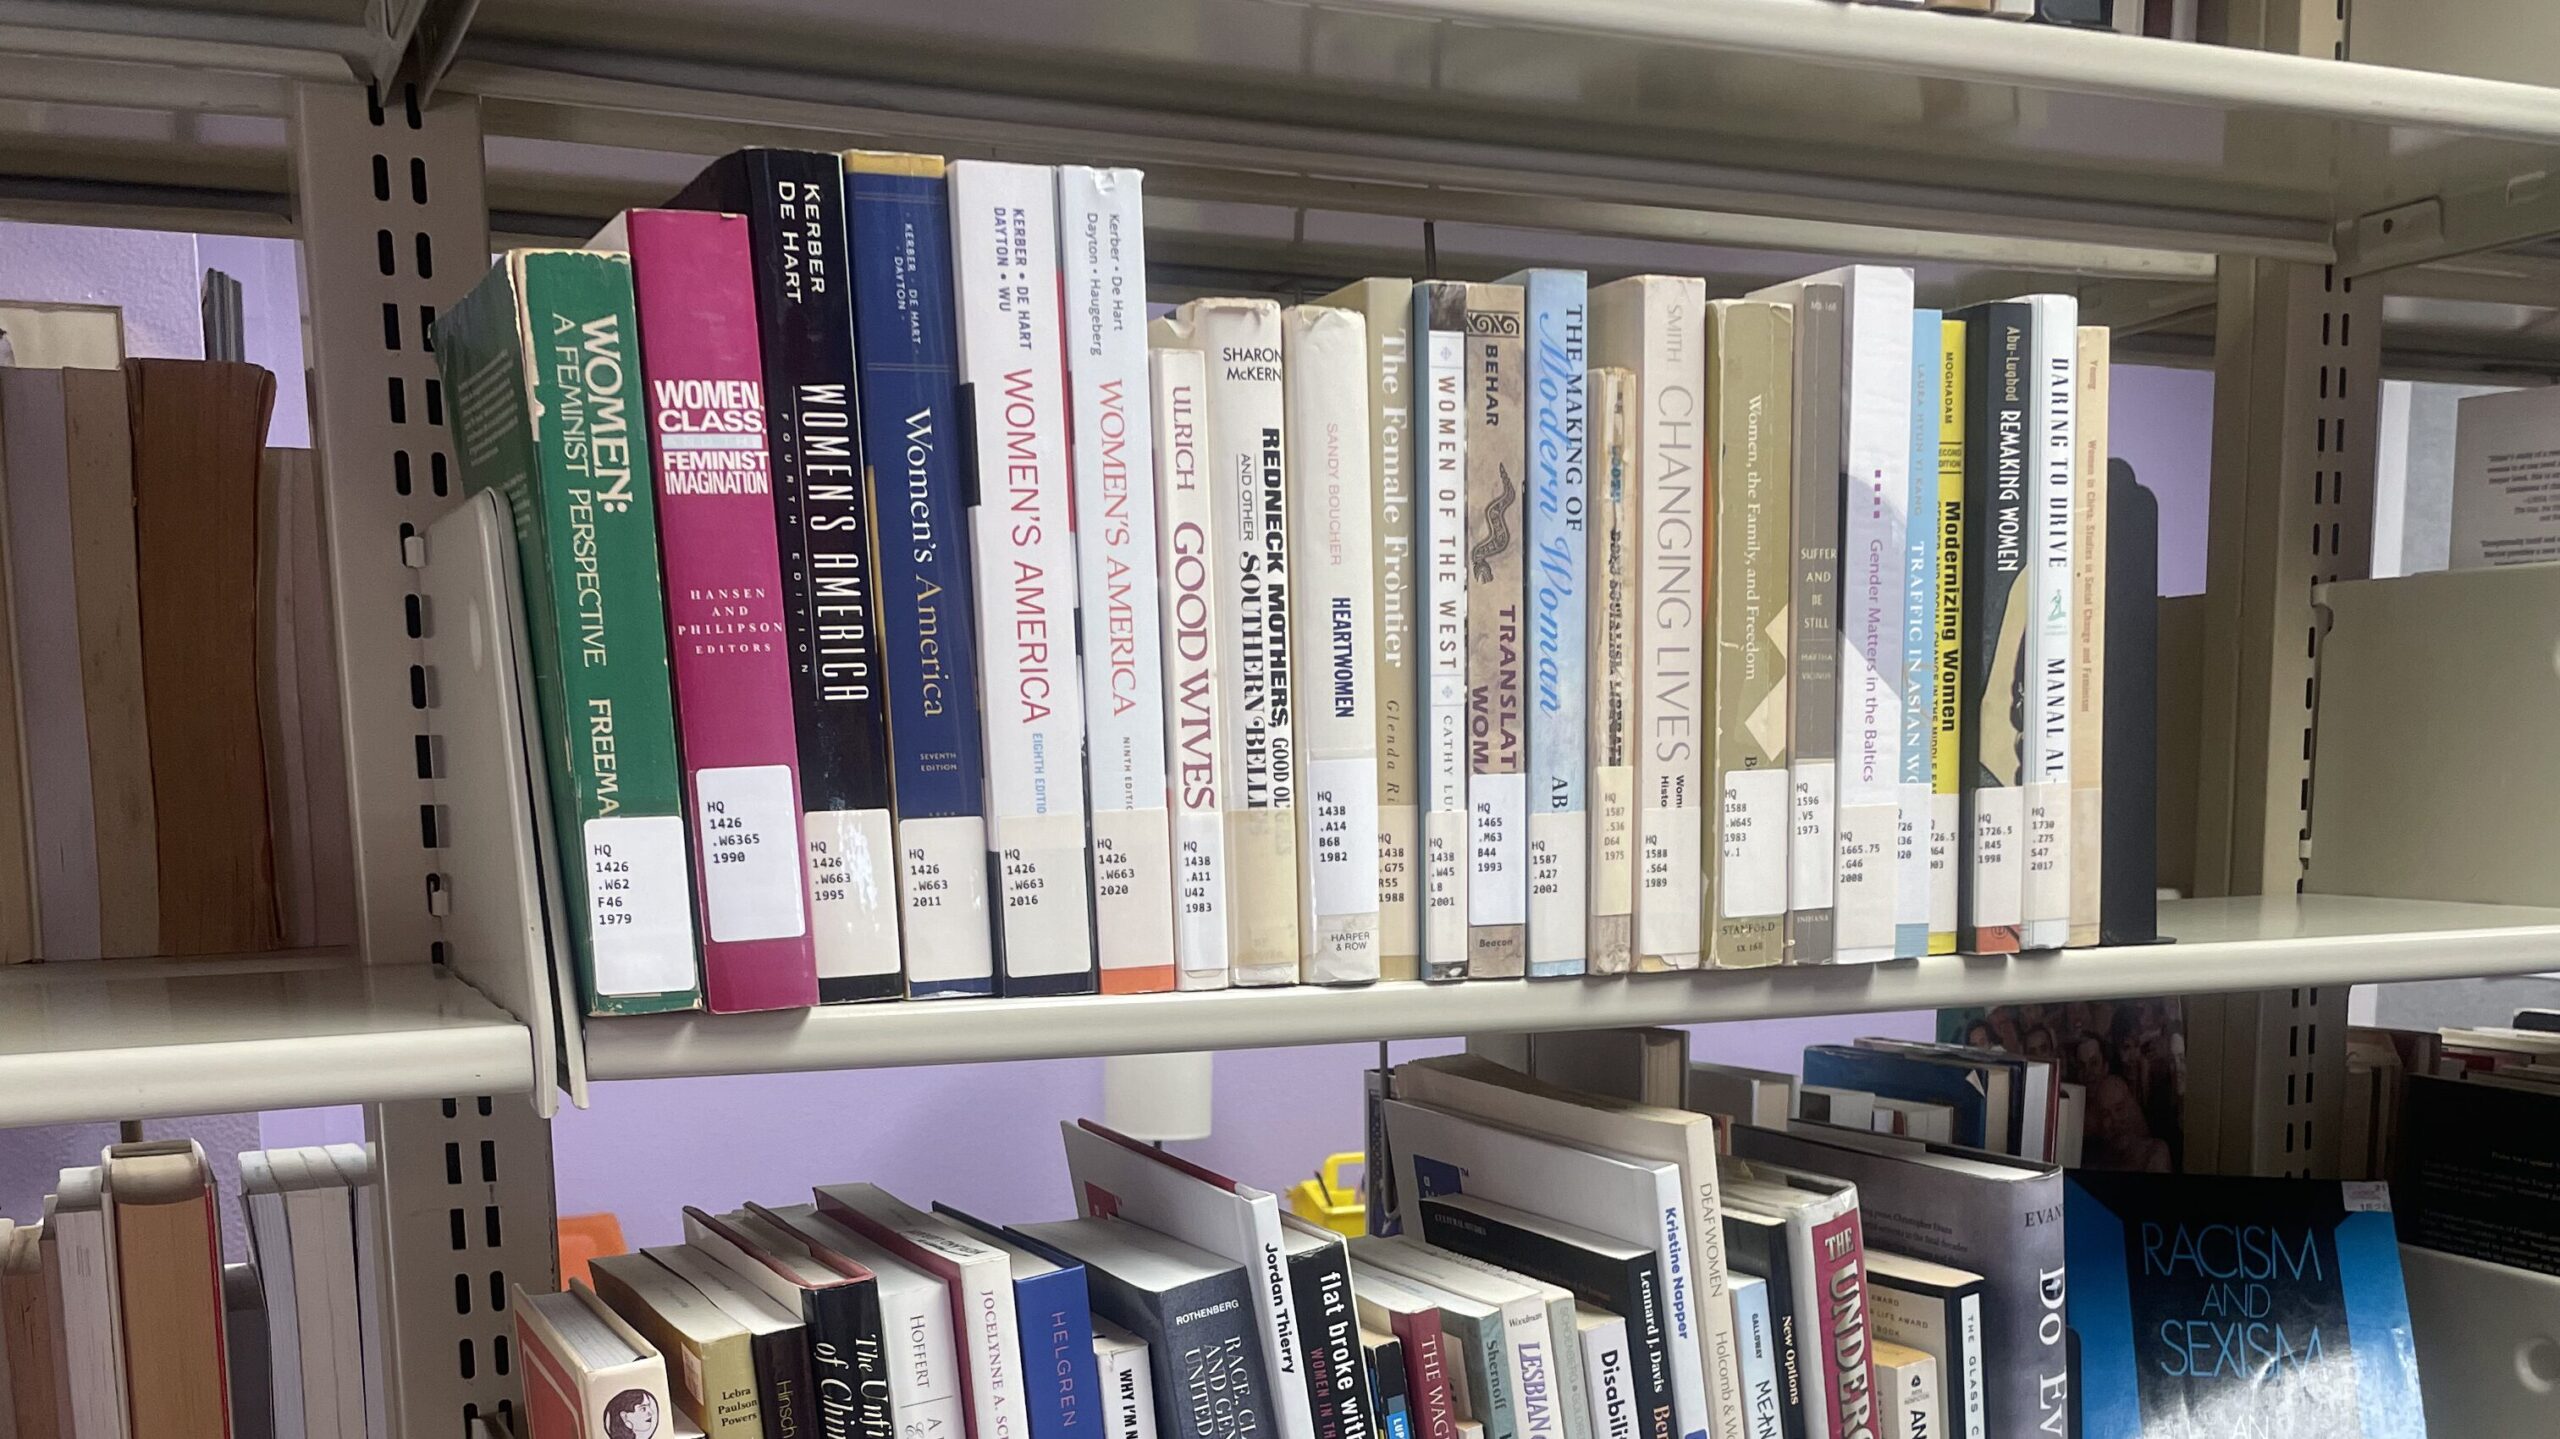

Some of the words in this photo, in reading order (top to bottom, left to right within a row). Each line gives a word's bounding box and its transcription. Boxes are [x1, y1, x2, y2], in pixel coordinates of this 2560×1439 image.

[778, 180, 796, 221] DE
[803, 182, 826, 294] KERBER
[993, 206, 1010, 267] DAYTON
[1012, 208, 1029, 267] KERBER
[1085, 212, 1099, 265] Dayton
[1109, 213, 1124, 263] Kerber
[782, 231, 802, 304] HART
[1018, 307, 1033, 351] HART
[1089, 278, 1103, 357] Haugeberg
[1566, 304, 1583, 363] THE
[1666, 303, 1683, 363] SMITH
[1382, 328, 1407, 395] The
[1485, 343, 1499, 427] BEHAR
[2005, 325, 2021, 403] Abu-Lughod
[555, 345, 590, 479] FEMINIST
[581, 313, 633, 513] WOMEN:
[654, 379, 766, 412] WOMEN,
[658, 409, 768, 435] CLASS,
[1539, 311, 1574, 523] Modern
[2051, 358, 2069, 448] DARING
[1172, 385, 1196, 492] ULRICH
[1438, 375, 1456, 472] WOMEN
[1566, 373, 1583, 486] MAKING
[663, 450, 769, 471] FEMINIST
[801, 384, 858, 532] WOMEN'S
[1003, 368, 1042, 547] WOMEN'S
[1098, 378, 1131, 547] WOMEN'S
[1327, 423, 1339, 483] SANDY
[1382, 406, 1408, 524] Female
[1998, 410, 2022, 501] REMAKING
[664, 471, 769, 495] IMAGINATION
[904, 405, 937, 565] Women's
[1262, 427, 1287, 575] REDNECK
[1438, 489, 1456, 518] OF
[1655, 384, 1694, 630] CHANGING
[1242, 489, 1255, 542] OTHER
[1328, 484, 1342, 566] BOUCHER
[1566, 498, 1583, 532] OF
[1997, 506, 2020, 572] WOMEN
[2048, 497, 2068, 569] DRIVE
[567, 487, 608, 668] PERSPECTIVE
[1439, 535, 1456, 583] THE
[1800, 547, 1838, 560] SUFFER
[1806, 572, 1832, 583] AND
[1868, 539, 1884, 604] Gender
[1941, 501, 1962, 641] Modernizing
[690, 587, 767, 600] HANSEN
[711, 606, 749, 617] AND
[1173, 521, 1209, 662] GOOD
[1383, 535, 1409, 668] Frontier
[1908, 541, 1925, 643] TRAFFIC
[677, 622, 784, 636] PHILIPSON
[695, 643, 772, 655] EDITORS
[813, 553, 870, 702] AMERICA
[914, 574, 951, 718] America
[1014, 560, 1052, 724] AMERICA
[1106, 555, 1137, 718] AMERICA
[1438, 600, 1457, 668] WEST
[1539, 535, 1574, 718] Woman
[1745, 605, 1761, 681] Freedom
[1804, 617, 1830, 629] STILL
[1866, 607, 1881, 672] Matters
[1266, 583, 1291, 728] MOTHERS,
[1331, 596, 1355, 718] HEARTWOMEN
[1655, 646, 1692, 763] LIVES
[1906, 678, 1921, 748] ASIAN
[1941, 649, 1960, 733] Women
[2046, 657, 2066, 740] MANAL
[1032, 732, 1045, 775] EIGHTH
[1179, 668, 1216, 810] WIVES
[1272, 736, 1290, 783] GOOD
[1443, 714, 1454, 776] CATHY
[1863, 729, 1878, 783] Baltics
[709, 817, 743, 830] 1426
[1318, 806, 1347, 817] 1438
[1477, 818, 1503, 828] 1465
[1724, 803, 1748, 813] 1588
[1978, 825, 2013, 837] 1726.5
[712, 851, 747, 864] 1990
[812, 857, 844, 869] 1426
[1098, 853, 1128, 865] 1426
[1184, 856, 1212, 867] 1438
[1319, 851, 1348, 864] 1982
[1378, 848, 1405, 858] 1438
[1532, 854, 1558, 865] 1587
[1724, 832, 1747, 843] 1983
[1840, 843, 1881, 855] 1665.75
[596, 861, 630, 873] 1426
[911, 864, 941, 876] 1426
[1006, 863, 1037, 876] 1426
[1100, 885, 1130, 896] 2020
[1532, 884, 1559, 895] 2002
[1645, 878, 1668, 888] 1989
[599, 914, 633, 926] 1979
[814, 889, 845, 901] 1995
[912, 896, 943, 908] 2011
[1009, 895, 1039, 907] 2016
[1185, 902, 1213, 914] 1983
[1378, 892, 1406, 903] 1988
[1430, 896, 1456, 908] 2001
[1331, 931, 1370, 943] HARPER
[1479, 938, 1514, 949] Beacon
[1699, 1182, 1715, 1225] DEAF
[1664, 1206, 1681, 1274] Kristine
[1702, 1225, 1724, 1299] WOMEN
[1824, 1227, 1856, 1262] THE
[2141, 1221, 2323, 1282] RACISM
[1175, 1299, 1240, 1326] ROTHENBERG
[1264, 1242, 1284, 1308] Jordan
[1275, 1308, 1295, 1375] Thierry
[1319, 1270, 1346, 1317] flat
[1508, 1311, 1543, 1328] Woodman
[1639, 1269, 1660, 1337] Lennard
[1672, 1276, 1688, 1341] Napper
[2038, 1263, 2066, 1346] DO
[2200, 1283, 2272, 1319] AND
[979, 1289, 1004, 1392] JOCELYNNE
[1645, 1337, 1660, 1349] J.
[1751, 1312, 1763, 1360] GALLOWAY
[1781, 1315, 1794, 1347] New
[1898, 1316, 1929, 1330] AWARD
[1967, 1314, 1976, 1344] THE
[2160, 1319, 2326, 1379] SEXISM
[815, 1342, 850, 1370] of
[855, 1333, 877, 1373] The
[909, 1314, 931, 1389] HOFFERT
[1050, 1311, 1078, 1428] HELGREN
[1203, 1344, 1228, 1392] AND
[1224, 1333, 1251, 1407] RACE,
[1309, 1347, 1332, 1398] WOMEN
[1327, 1321, 1355, 1392] broke
[1420, 1333, 1442, 1383] THE
[1486, 1339, 1508, 1412] Shernoff
[1649, 1351, 1664, 1395] Davis
[1714, 1330, 1731, 1404] Holcomb
[1784, 1348, 1800, 1407] Options
[717, 1399, 758, 1415] Paulson
[721, 1388, 751, 1401] Lebra
[776, 1379, 798, 1439] Hinsch
[991, 1396, 1007, 1412] A.
[1118, 1368, 1135, 1401] WHY
[1184, 1347, 1216, 1437] UNITED
[1318, 1402, 1334, 1417] IN
[1517, 1341, 1553, 1431] LESBIAN
[1722, 1404, 1733, 1417] &
[1969, 1355, 1980, 1413] GLASS
[720, 1412, 758, 1427] Powers
[1122, 1403, 1138, 1428] I'M
